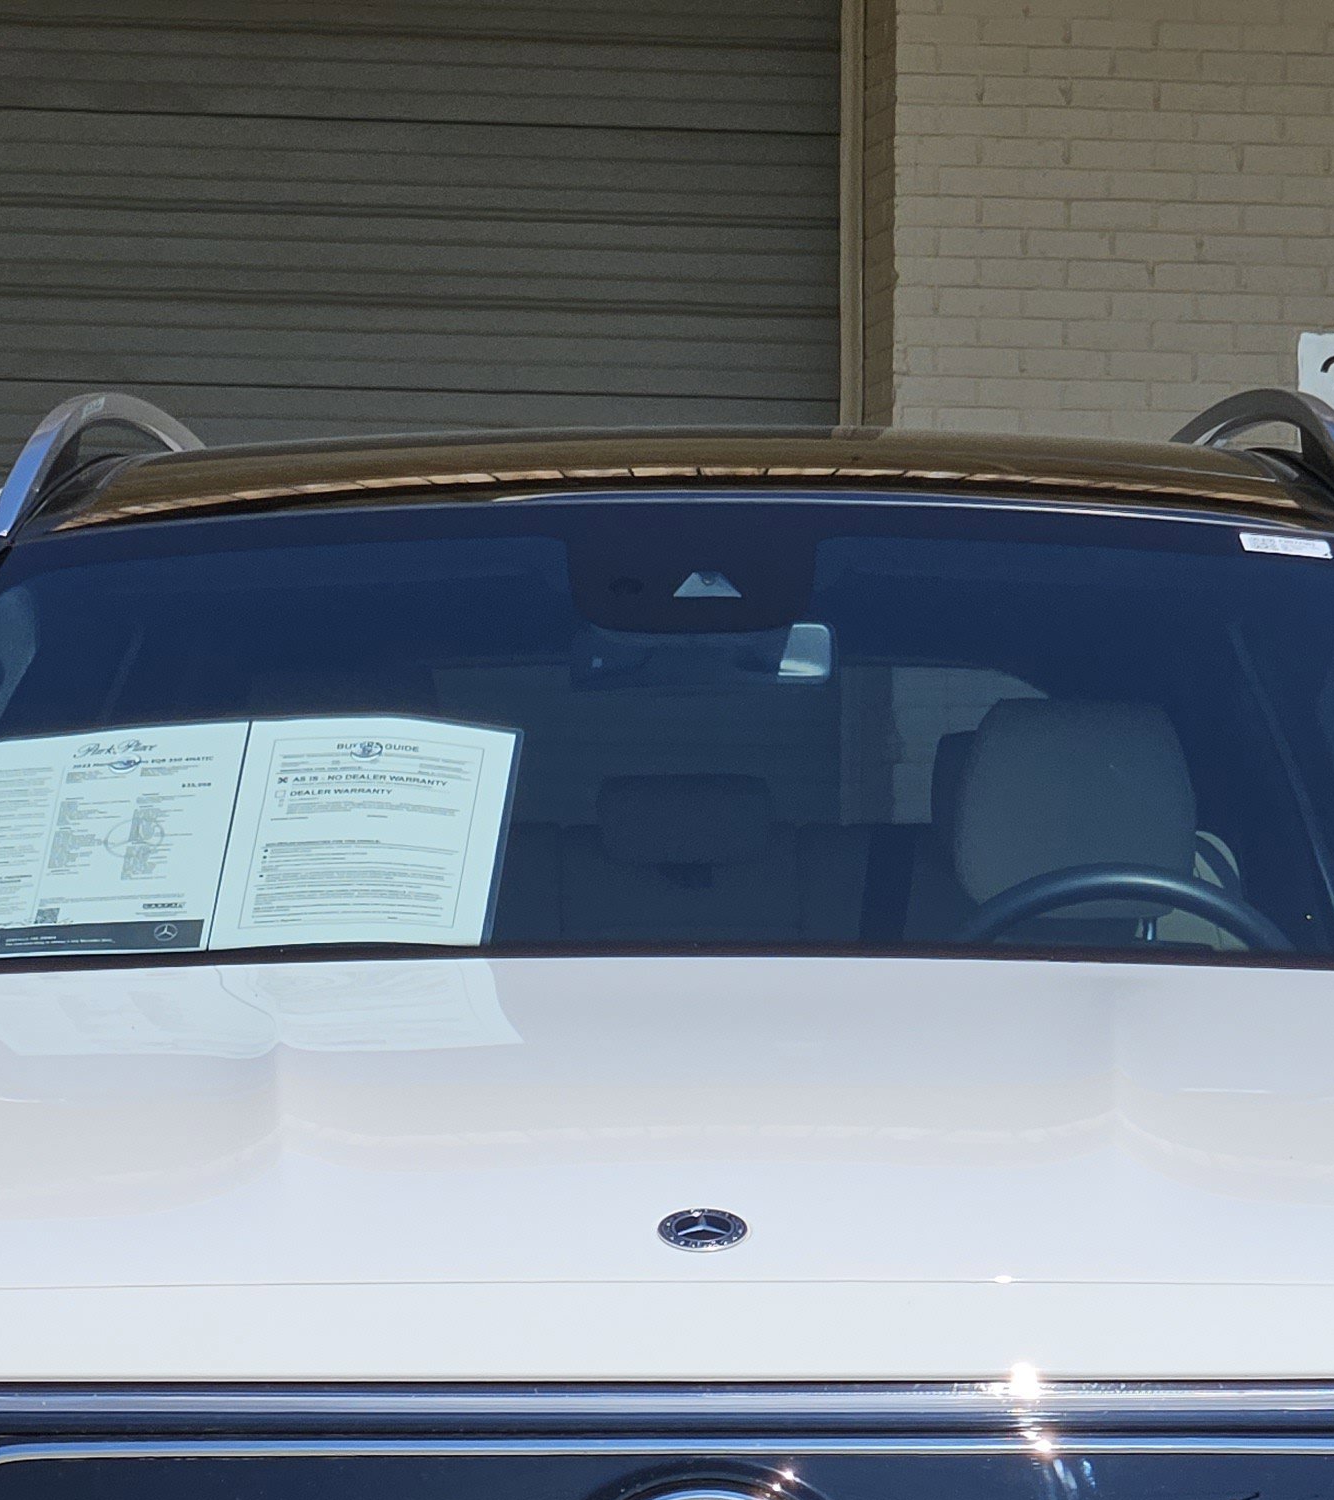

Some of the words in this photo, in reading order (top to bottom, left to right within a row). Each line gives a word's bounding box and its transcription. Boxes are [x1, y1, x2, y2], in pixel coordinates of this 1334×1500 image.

[384, 743, 420, 752] GUIDE
[345, 774, 387, 782] DEALER
[389, 775, 449, 787] WARRANTY
[289, 789, 331, 797] DEALER
[333, 788, 393, 796] WARRANTY
